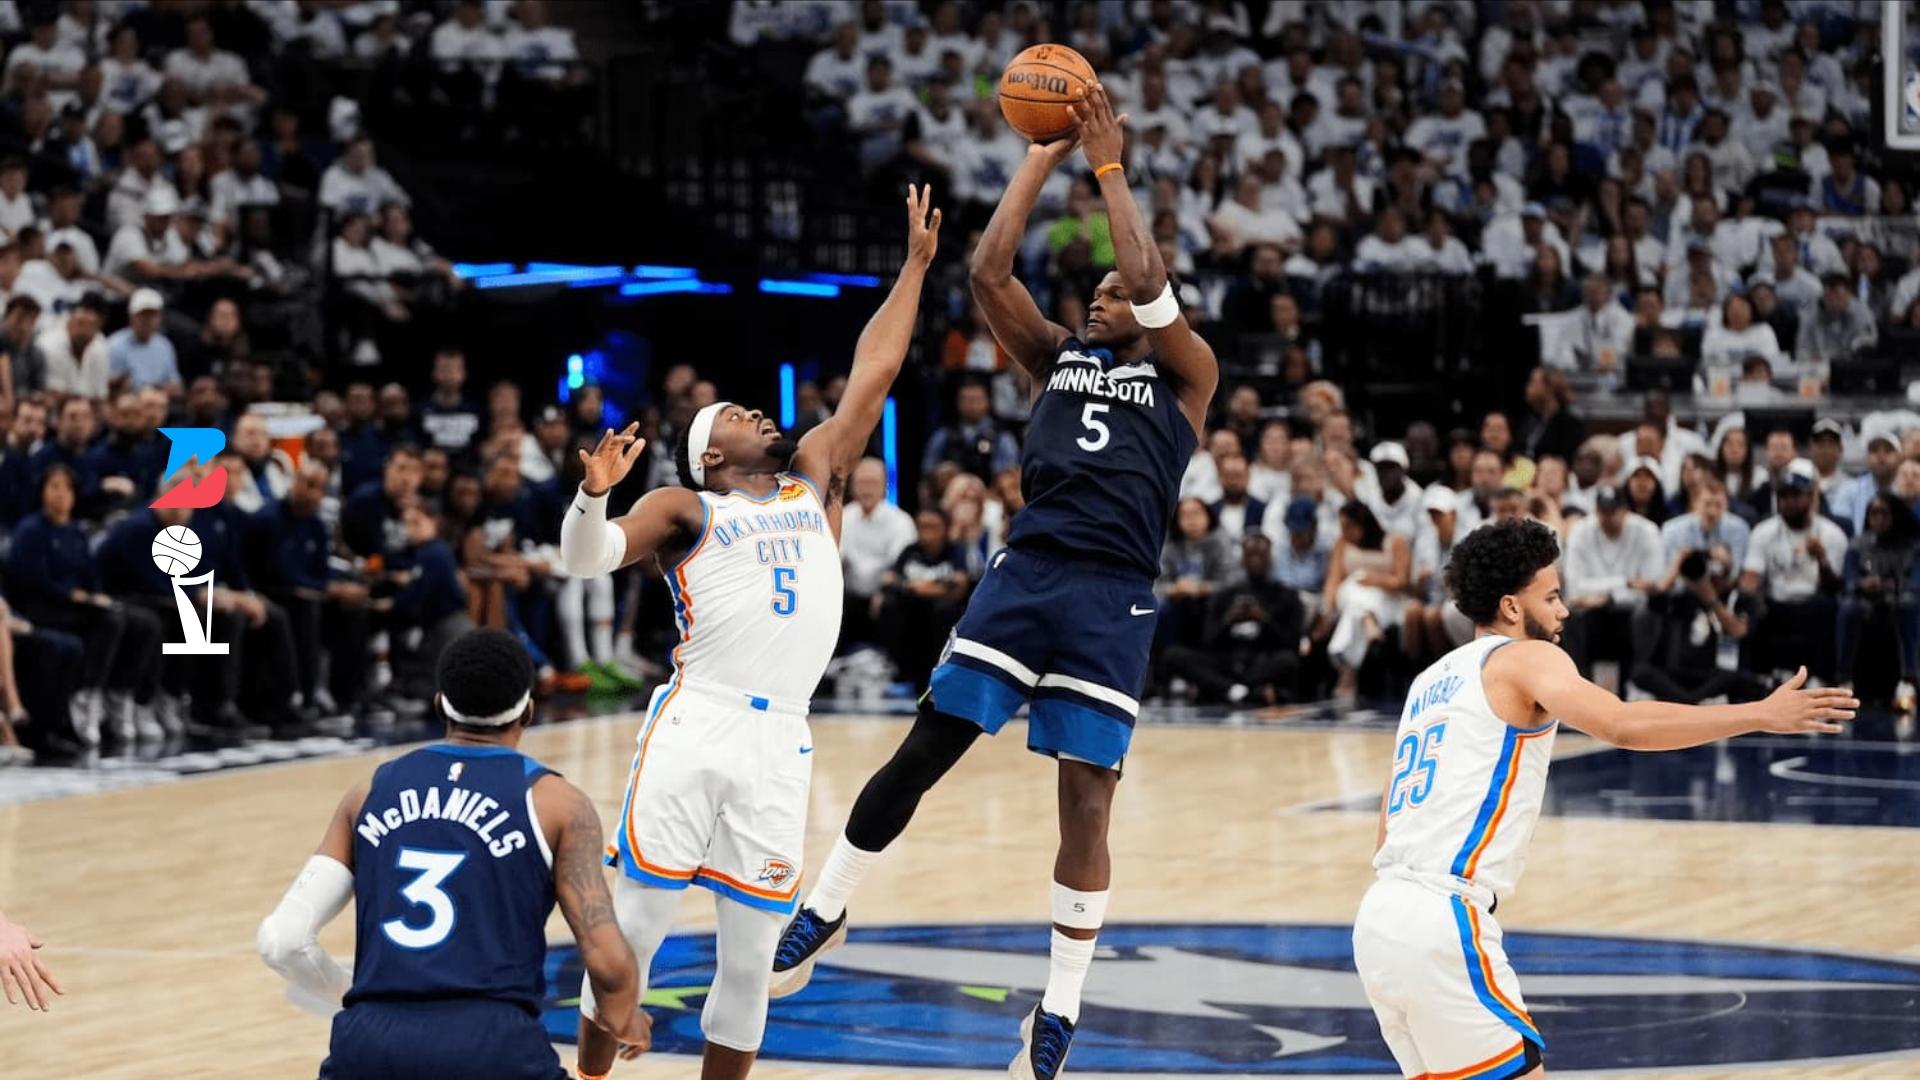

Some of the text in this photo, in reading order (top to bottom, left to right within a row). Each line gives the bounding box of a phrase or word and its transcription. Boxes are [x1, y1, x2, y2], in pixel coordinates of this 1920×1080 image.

[1007, 71, 1068, 95] Wilson
[1046, 367, 1155, 408] MINNESOTA
[1076, 402, 1110, 452] 5
[713, 511, 824, 548] OKLAHOMA
[756, 538, 803, 565] CITY
[771, 566, 798, 618] 5
[1387, 719, 1448, 816] 25
[357, 786, 527, 859] McDANIELS
[381, 846, 468, 949] 3
[1073, 902, 1085, 913] 5
